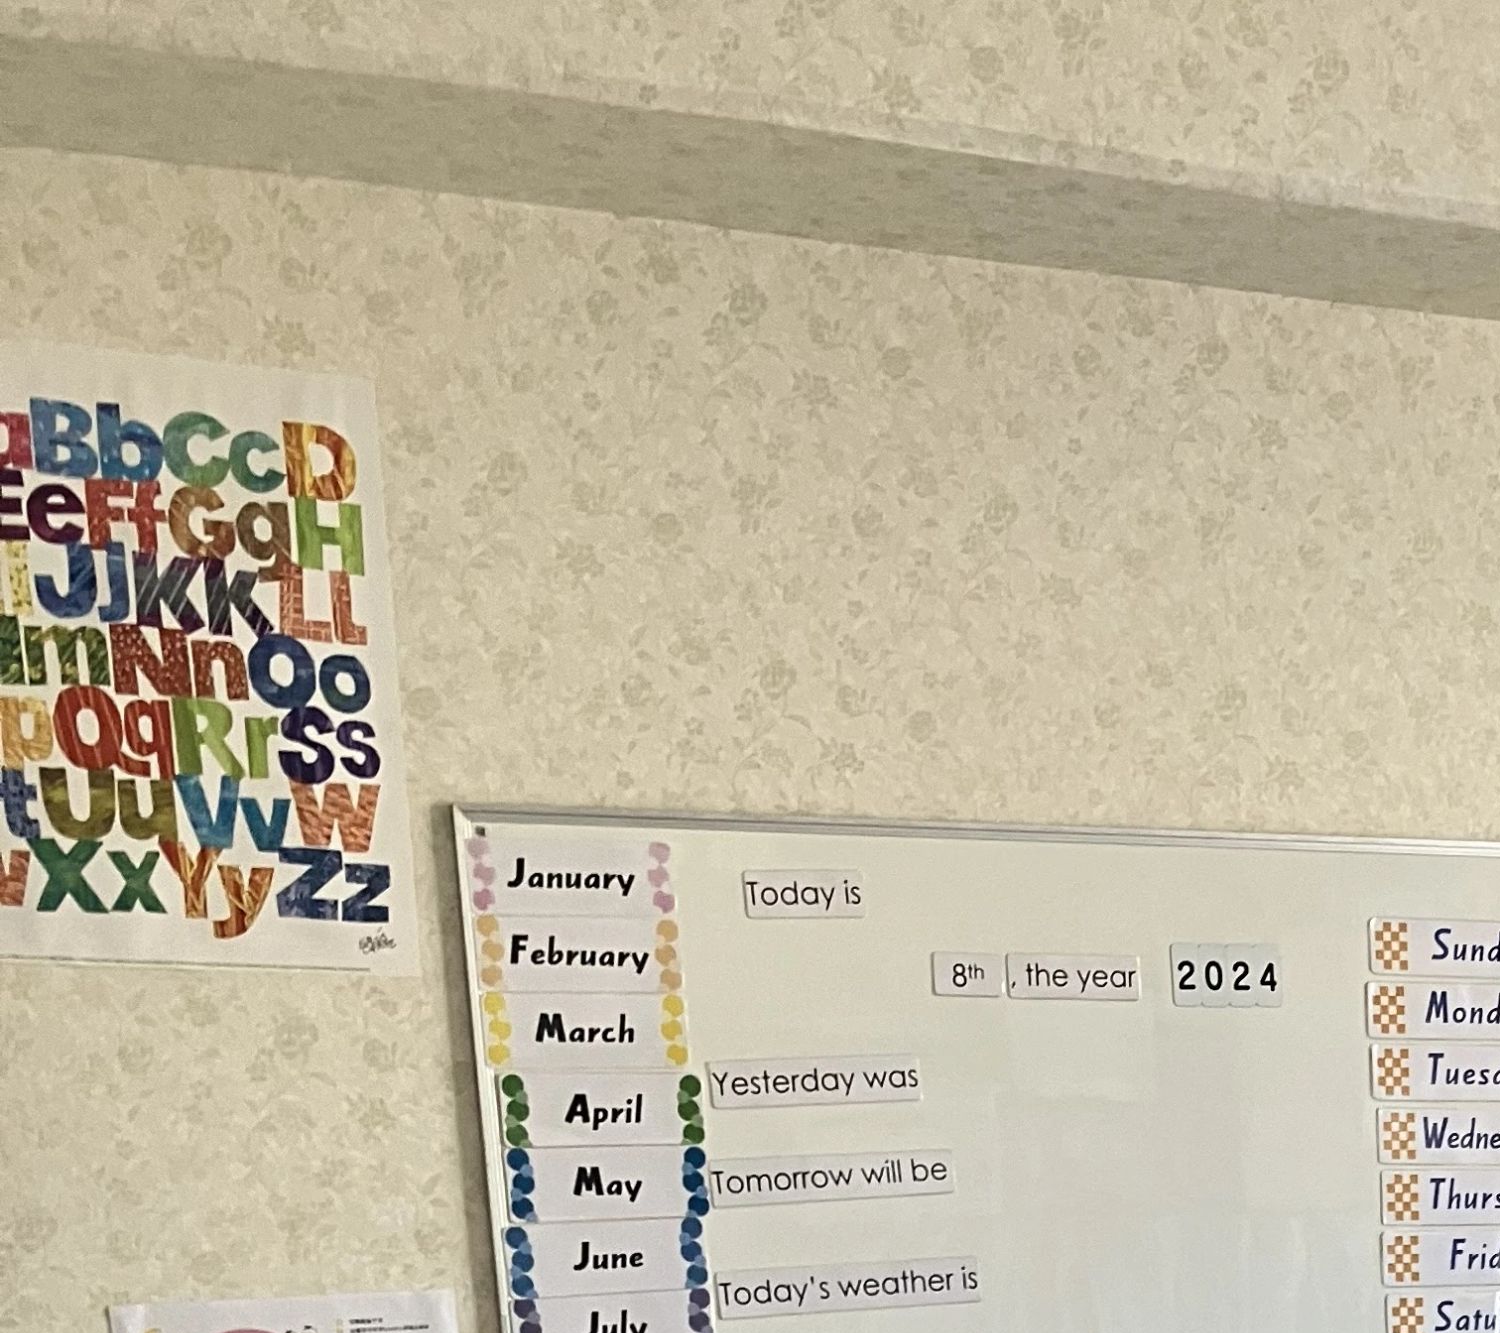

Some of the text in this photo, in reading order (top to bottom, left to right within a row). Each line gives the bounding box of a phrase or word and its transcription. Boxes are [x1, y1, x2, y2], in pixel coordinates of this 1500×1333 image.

[506, 857, 636, 897] January
[744, 879, 861, 911] Today is
[510, 934, 650, 975] February
[952, 963, 985, 988] 8th
[1025, 962, 1069, 988] the
[1076, 969, 1137, 994] year
[1177, 960, 1278, 992] 2024
[535, 1012, 635, 1044] March
[711, 1065, 919, 1097] Yesterday was
[564, 1093, 643, 1131] April
[573, 1166, 643, 1203] May
[710, 1158, 947, 1195] Tomorrow will be
[573, 1241, 644, 1271] June
[718, 1265, 978, 1308] Today's weather is
